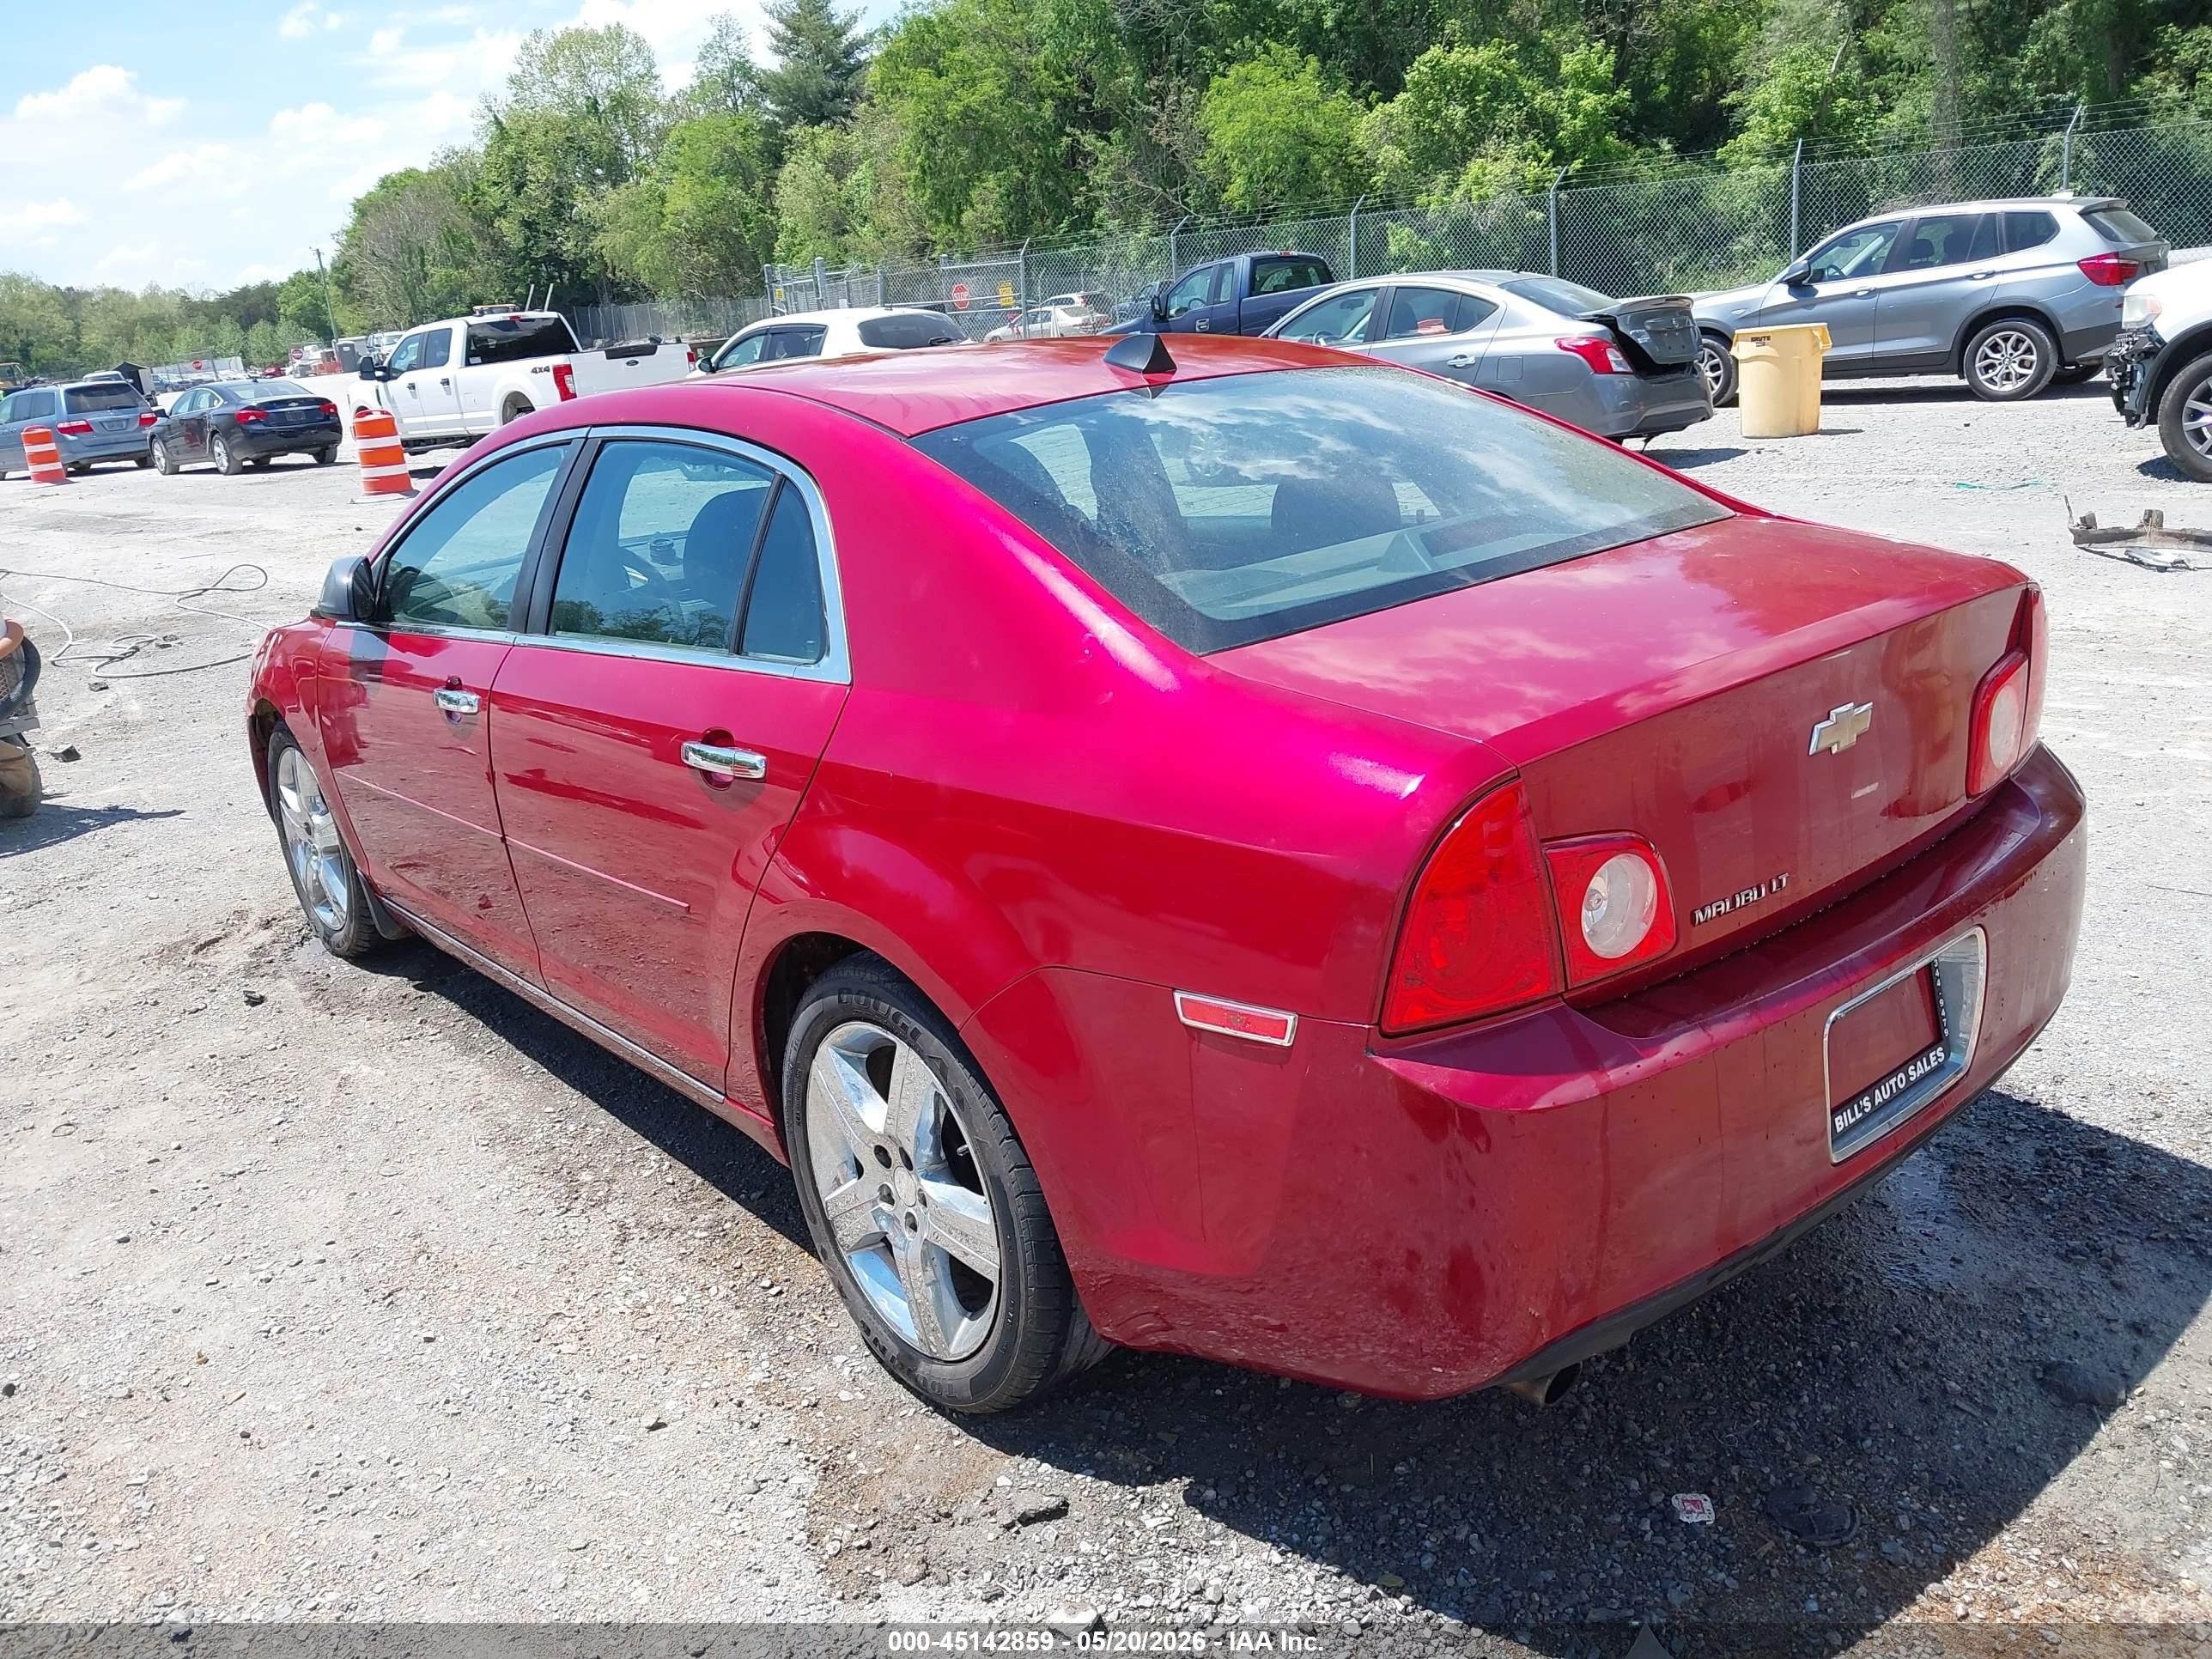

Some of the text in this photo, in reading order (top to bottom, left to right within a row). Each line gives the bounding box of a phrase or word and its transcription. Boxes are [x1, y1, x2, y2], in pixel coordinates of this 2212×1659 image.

[1692, 872, 1790, 927] MALIBU LT
[1834, 1046, 1945, 1133] BILL'S AUTO SALES
